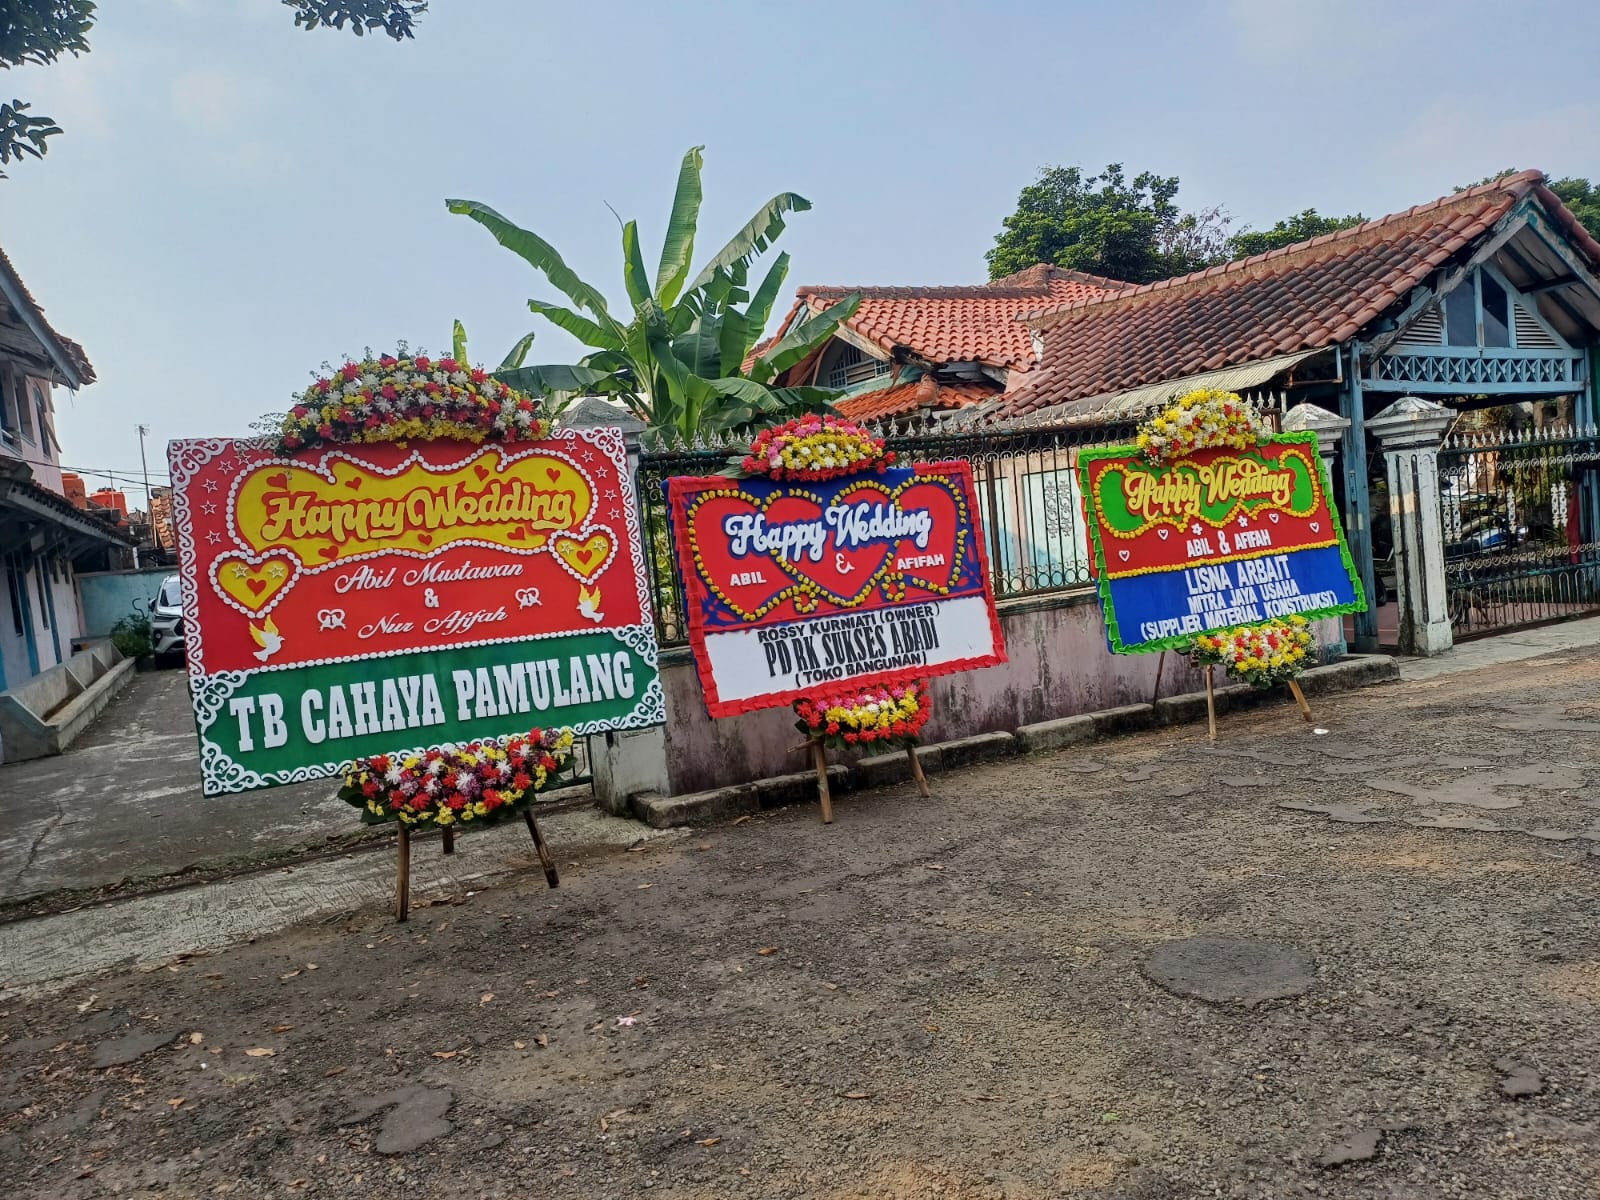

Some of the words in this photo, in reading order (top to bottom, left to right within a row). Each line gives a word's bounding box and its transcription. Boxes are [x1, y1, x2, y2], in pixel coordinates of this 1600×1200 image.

[1125, 471, 1201, 521] Happy
[1200, 458, 1290, 505] Wedding
[261, 496, 404, 542] Happy
[406, 482, 573, 530] Wedding
[725, 513, 826, 561] Happy
[826, 503, 932, 547] Wedding
[1186, 539, 1214, 558] ABIL
[1217, 530, 1231, 554] &
[1234, 530, 1272, 551] AFIFAH
[334, 564, 397, 594] Abil
[403, 561, 523, 586] Mustawan
[835, 552, 854, 574] &
[897, 554, 945, 570] AFIFAH
[1185, 566, 1233, 595] LISNA
[1236, 555, 1291, 587] ARBAIT
[729, 572, 767, 586] ABIL
[424, 588, 439, 607] &
[1187, 595, 1227, 615] MITRA
[1230, 587, 1259, 607] JAYA
[1260, 579, 1300, 599] USAHA
[358, 613, 414, 638] Nur
[424, 606, 508, 635] Afifah
[757, 625, 805, 643] ROSSY
[809, 614, 877, 635] KURNIATI
[1140, 616, 1203, 641] (SUPPLIER
[1204, 603, 1263, 630] MATERIAL
[1263, 590, 1338, 618] KONSTRUKSI)
[763, 640, 792, 677] PD
[792, 636, 821, 672] RK
[822, 625, 888, 667] SUKSES
[890, 617, 940, 655] ABADI
[845, 651, 928, 676] BANGUNAN)
[229, 692, 288, 753] TB
[300, 673, 445, 744] CAHAYA
[453, 650, 635, 721] PAMULANG
